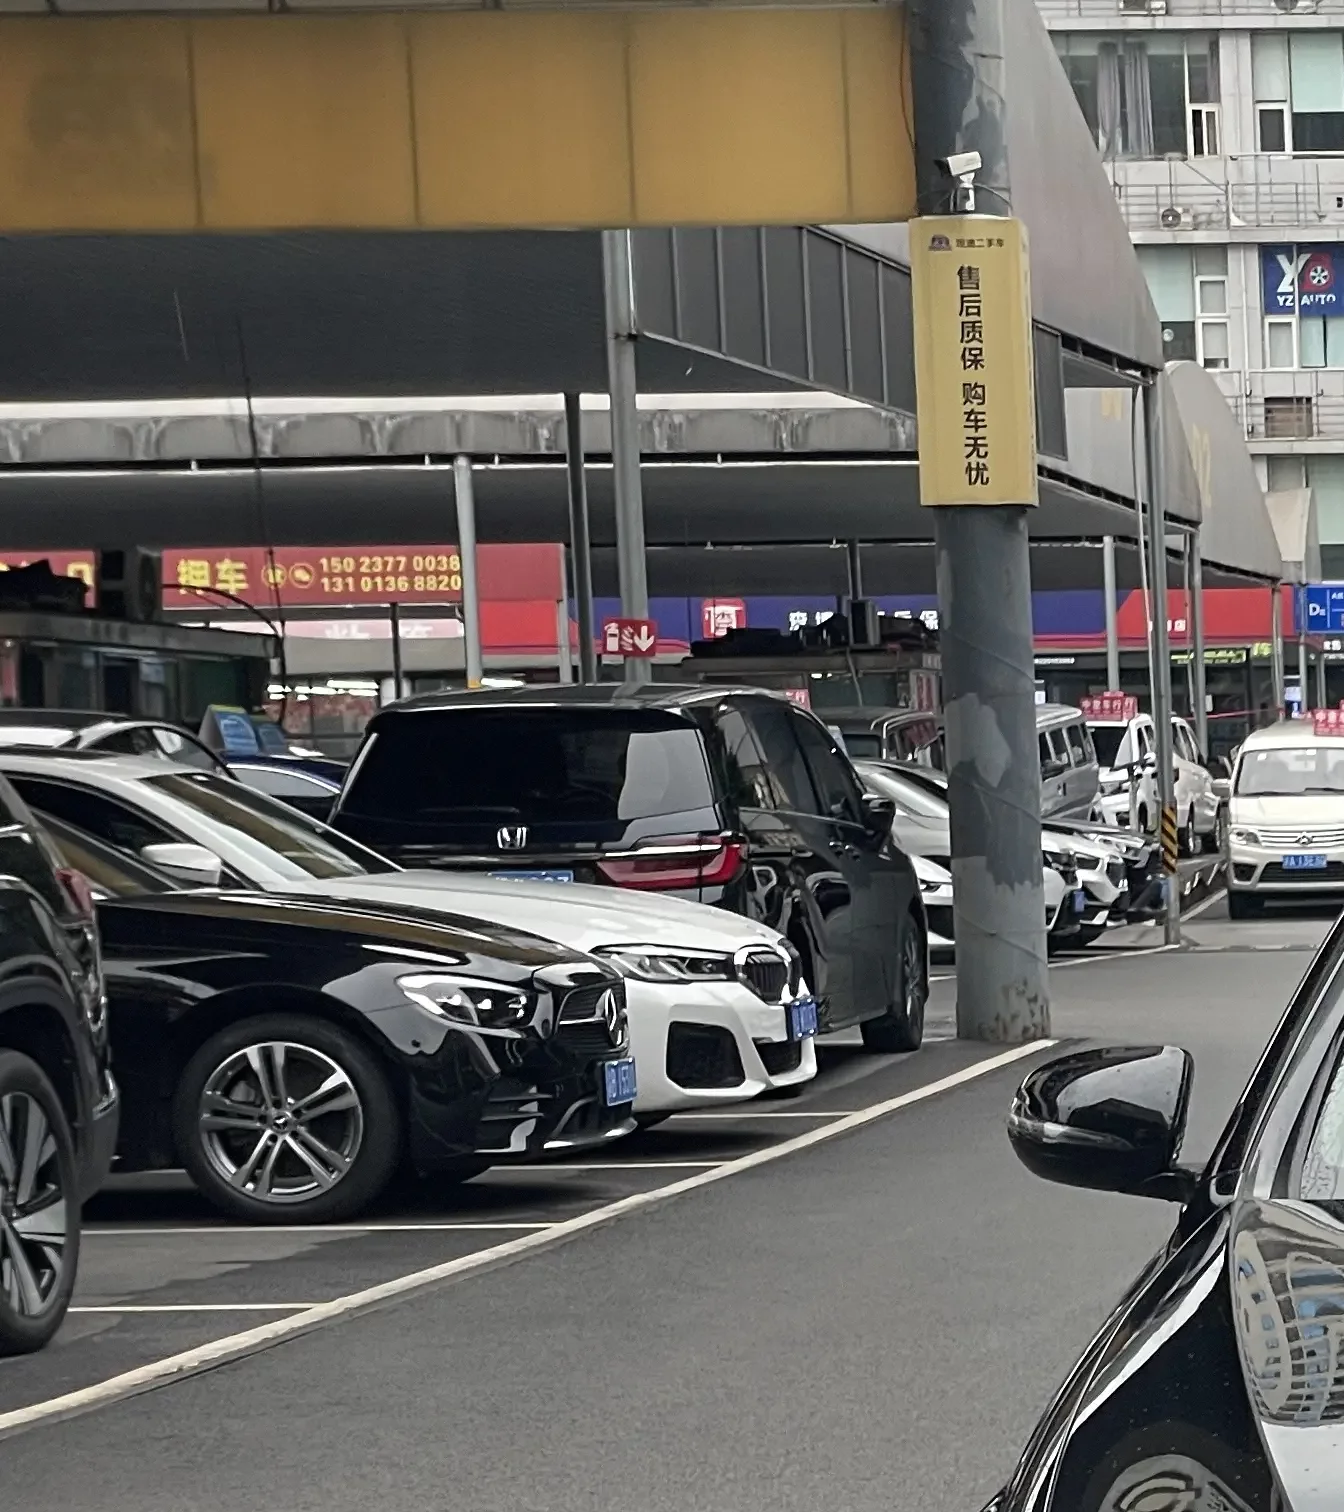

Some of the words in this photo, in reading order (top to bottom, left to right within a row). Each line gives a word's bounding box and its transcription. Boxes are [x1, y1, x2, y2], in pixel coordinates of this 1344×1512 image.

[957, 264, 985, 370] 售后质保
[962, 382, 990, 486] 购车无忧
[319, 557, 355, 574] 150
[359, 556, 406, 573] 2377
[321, 576, 355, 592] 131
[360, 575, 409, 591] 0136
[413, 574, 461, 591] 8820
